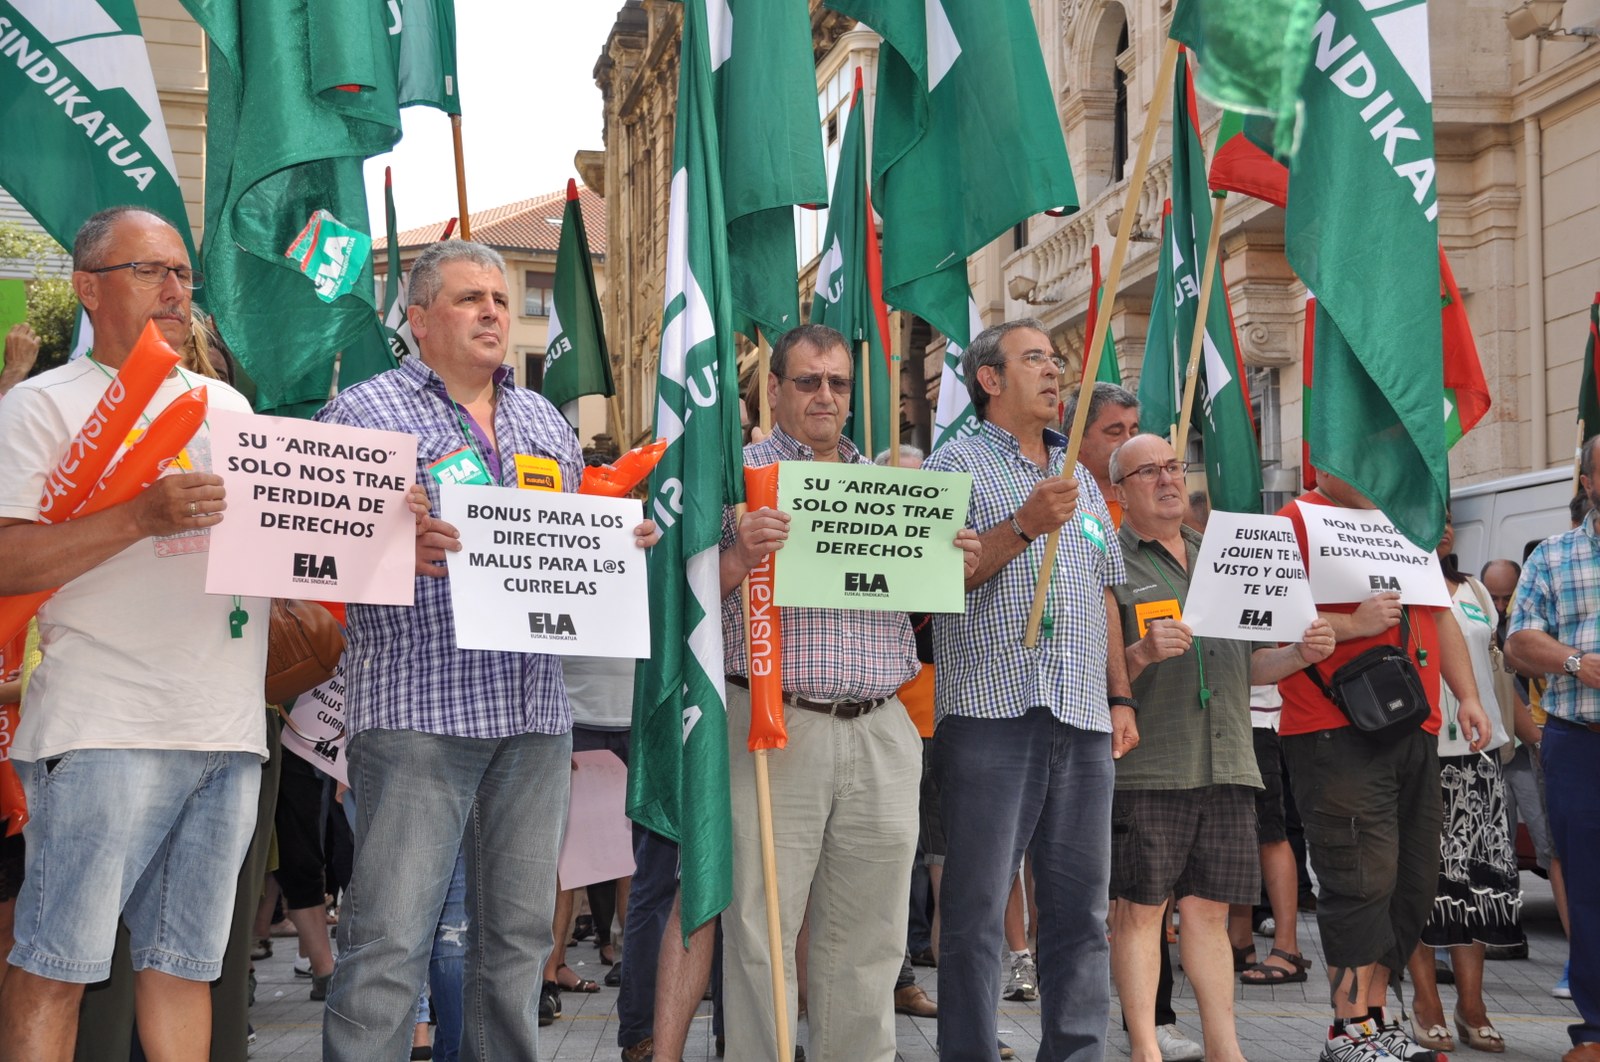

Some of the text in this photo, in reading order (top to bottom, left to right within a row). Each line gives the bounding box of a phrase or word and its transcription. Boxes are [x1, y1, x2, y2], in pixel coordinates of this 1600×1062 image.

[0, 16, 157, 192] SINDIKATUA
[238, 432, 267, 449] SU
[228, 456, 405, 492] SOLO NOS TRAE
[437, 458, 480, 484] ELA
[804, 477, 830, 491] SU
[253, 485, 385, 514] PERDIDA DE
[792, 498, 954, 520] SOLO NOS TRAE
[260, 512, 375, 538] DERECHOS
[467, 504, 624, 529] BONUS PARA LOS
[1322, 518, 1357, 531] NON
[811, 520, 931, 539] PERDIDA DE
[1235, 528, 1296, 544] EUSKALTEL
[493, 530, 601, 550] DIRECTIVOS
[816, 541, 923, 559] DERECHOS
[1337, 533, 1404, 549] ENPRESA
[469, 552, 626, 575] MALUS PARA L@S
[1220, 546, 1273, 560] ¡QUIEN
[1277, 549, 1290, 561] TE
[1320, 546, 1429, 566] EUSKALDUNA?
[293, 552, 338, 580] ELA
[1213, 562, 1259, 577] VISTO
[1263, 567, 1272, 578] Y
[503, 578, 597, 595] CURRELAS
[750, 506, 772, 677] euskalt
[845, 572, 889, 593] ELA
[1244, 583, 1288, 597] TE VE!
[1368, 575, 1402, 591] ELA
[528, 612, 577, 635] ELA
[1239, 609, 1272, 627] ELA
[311, 688, 343, 712] MALUS
[313, 737, 339, 762] ELA
